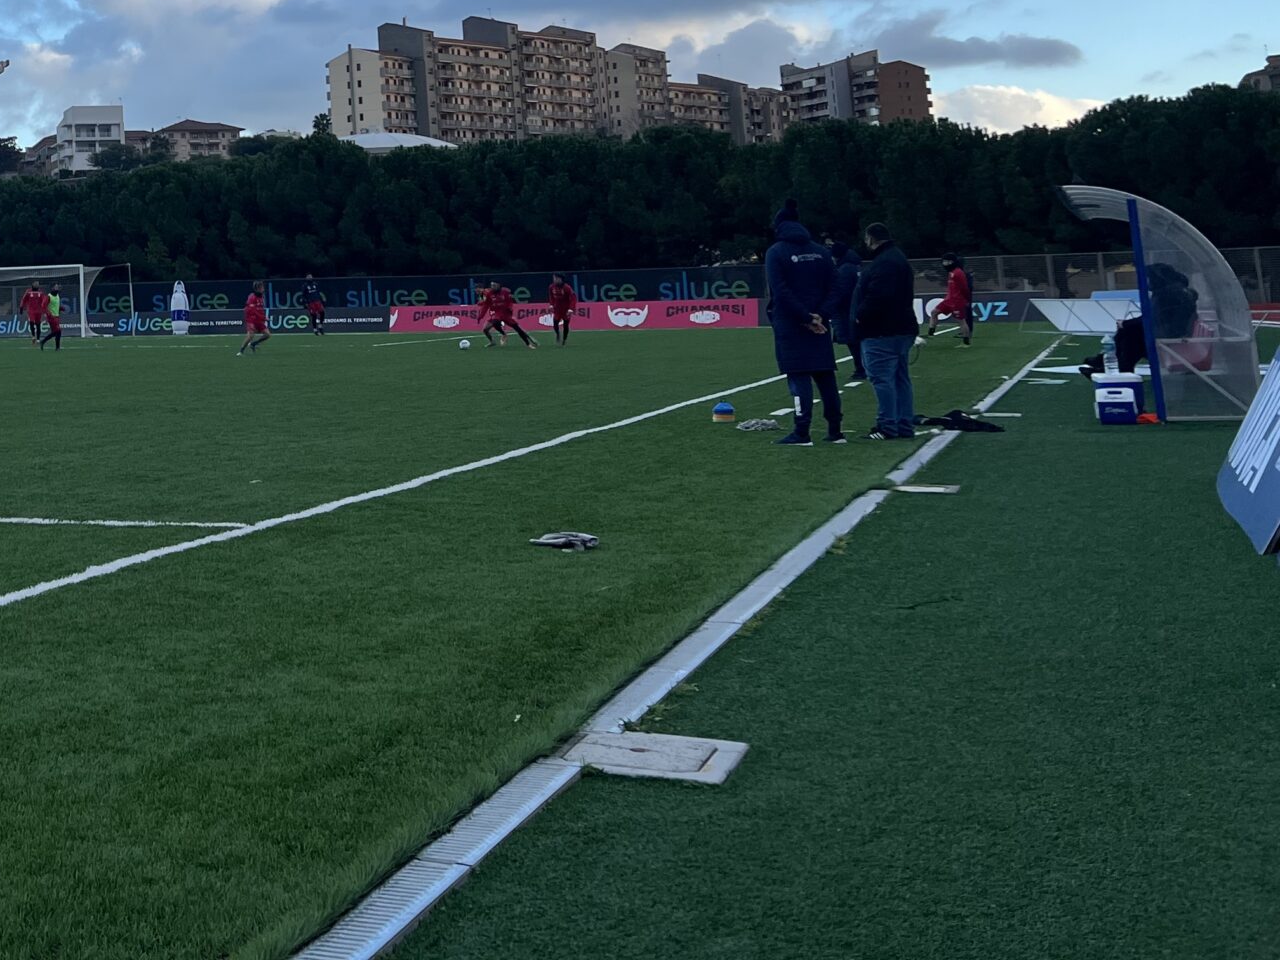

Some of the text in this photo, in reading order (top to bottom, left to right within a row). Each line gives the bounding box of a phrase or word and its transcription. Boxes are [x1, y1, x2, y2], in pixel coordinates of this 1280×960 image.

[346, 280, 428, 308] siluce
[448, 278, 531, 306] sile
[573, 274, 638, 302] luce
[659, 271, 750, 301] siluce
[60, 296, 131, 314] siuce
[667, 304, 744, 317] CHIAMARSI
